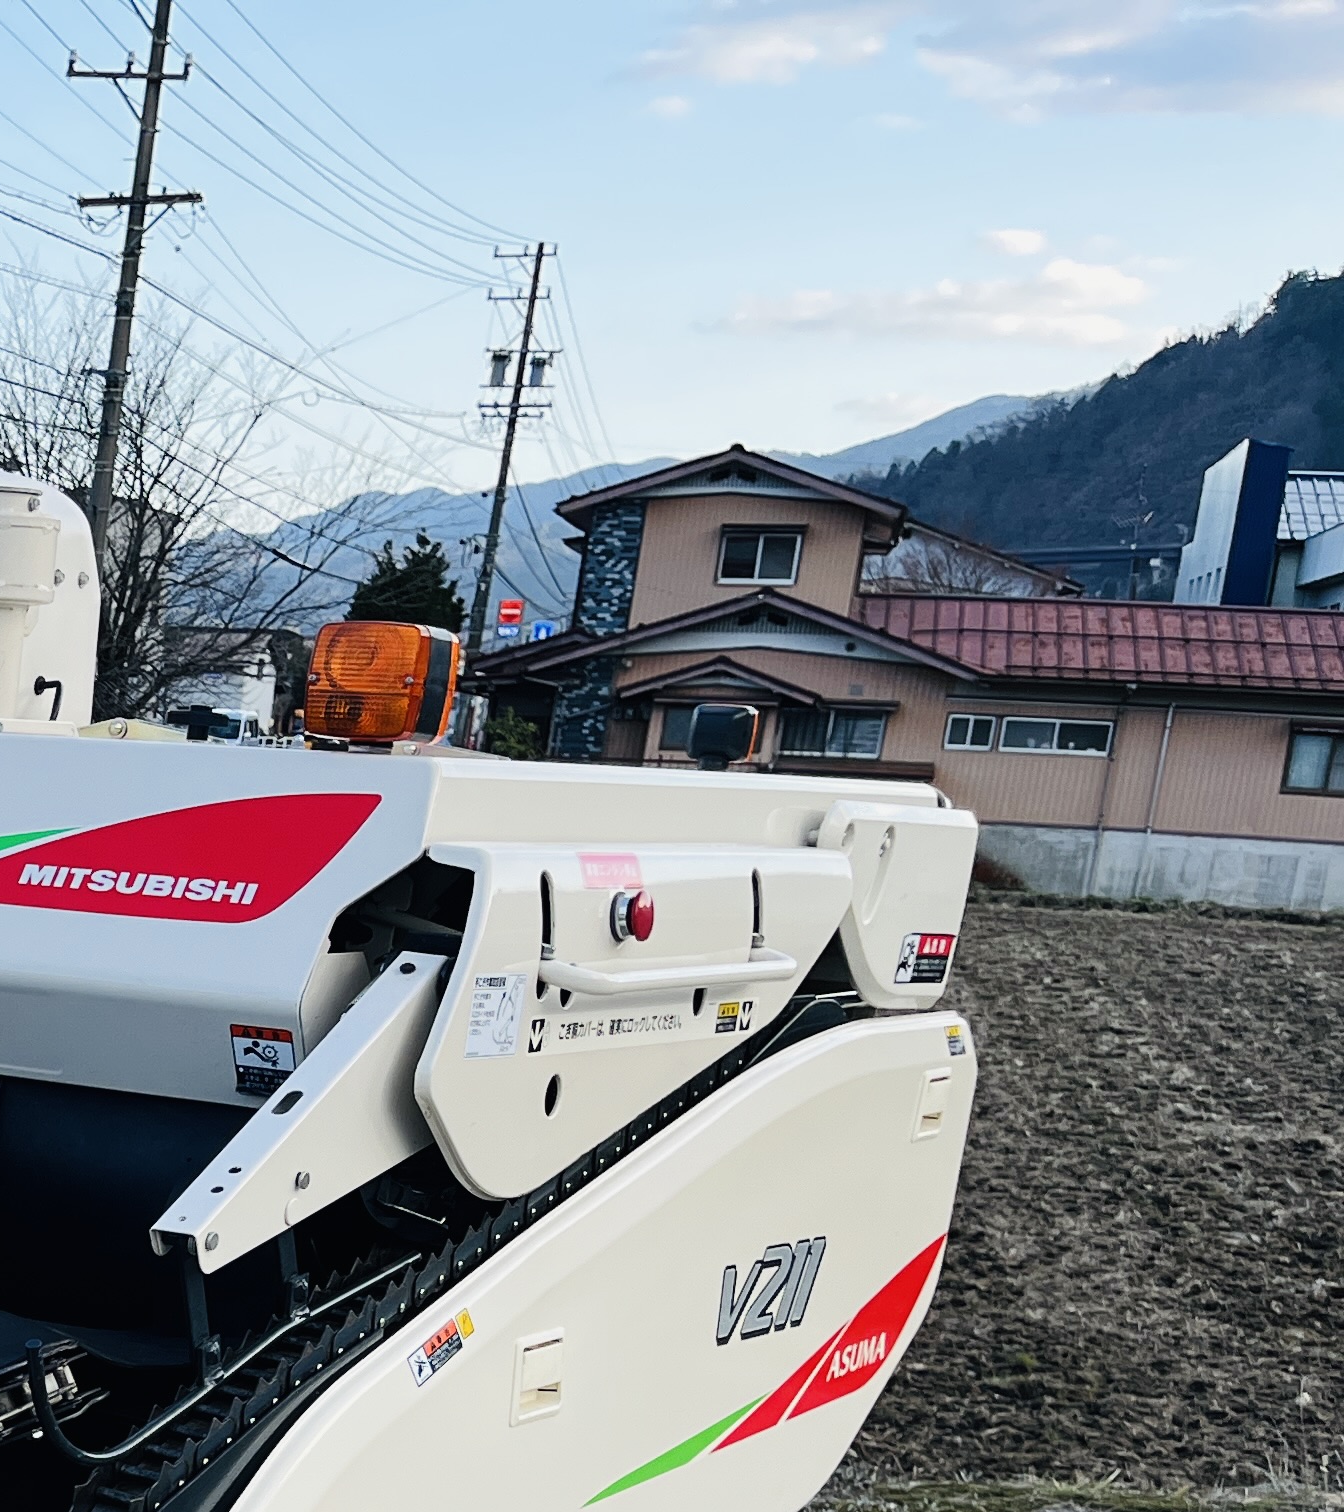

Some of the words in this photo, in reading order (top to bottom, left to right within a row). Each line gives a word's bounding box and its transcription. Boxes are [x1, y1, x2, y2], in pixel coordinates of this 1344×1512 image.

[18, 863, 259, 905] MITSUBISHI
[715, 1235, 827, 1347] V211
[825, 1332, 888, 1383] ASUMA
